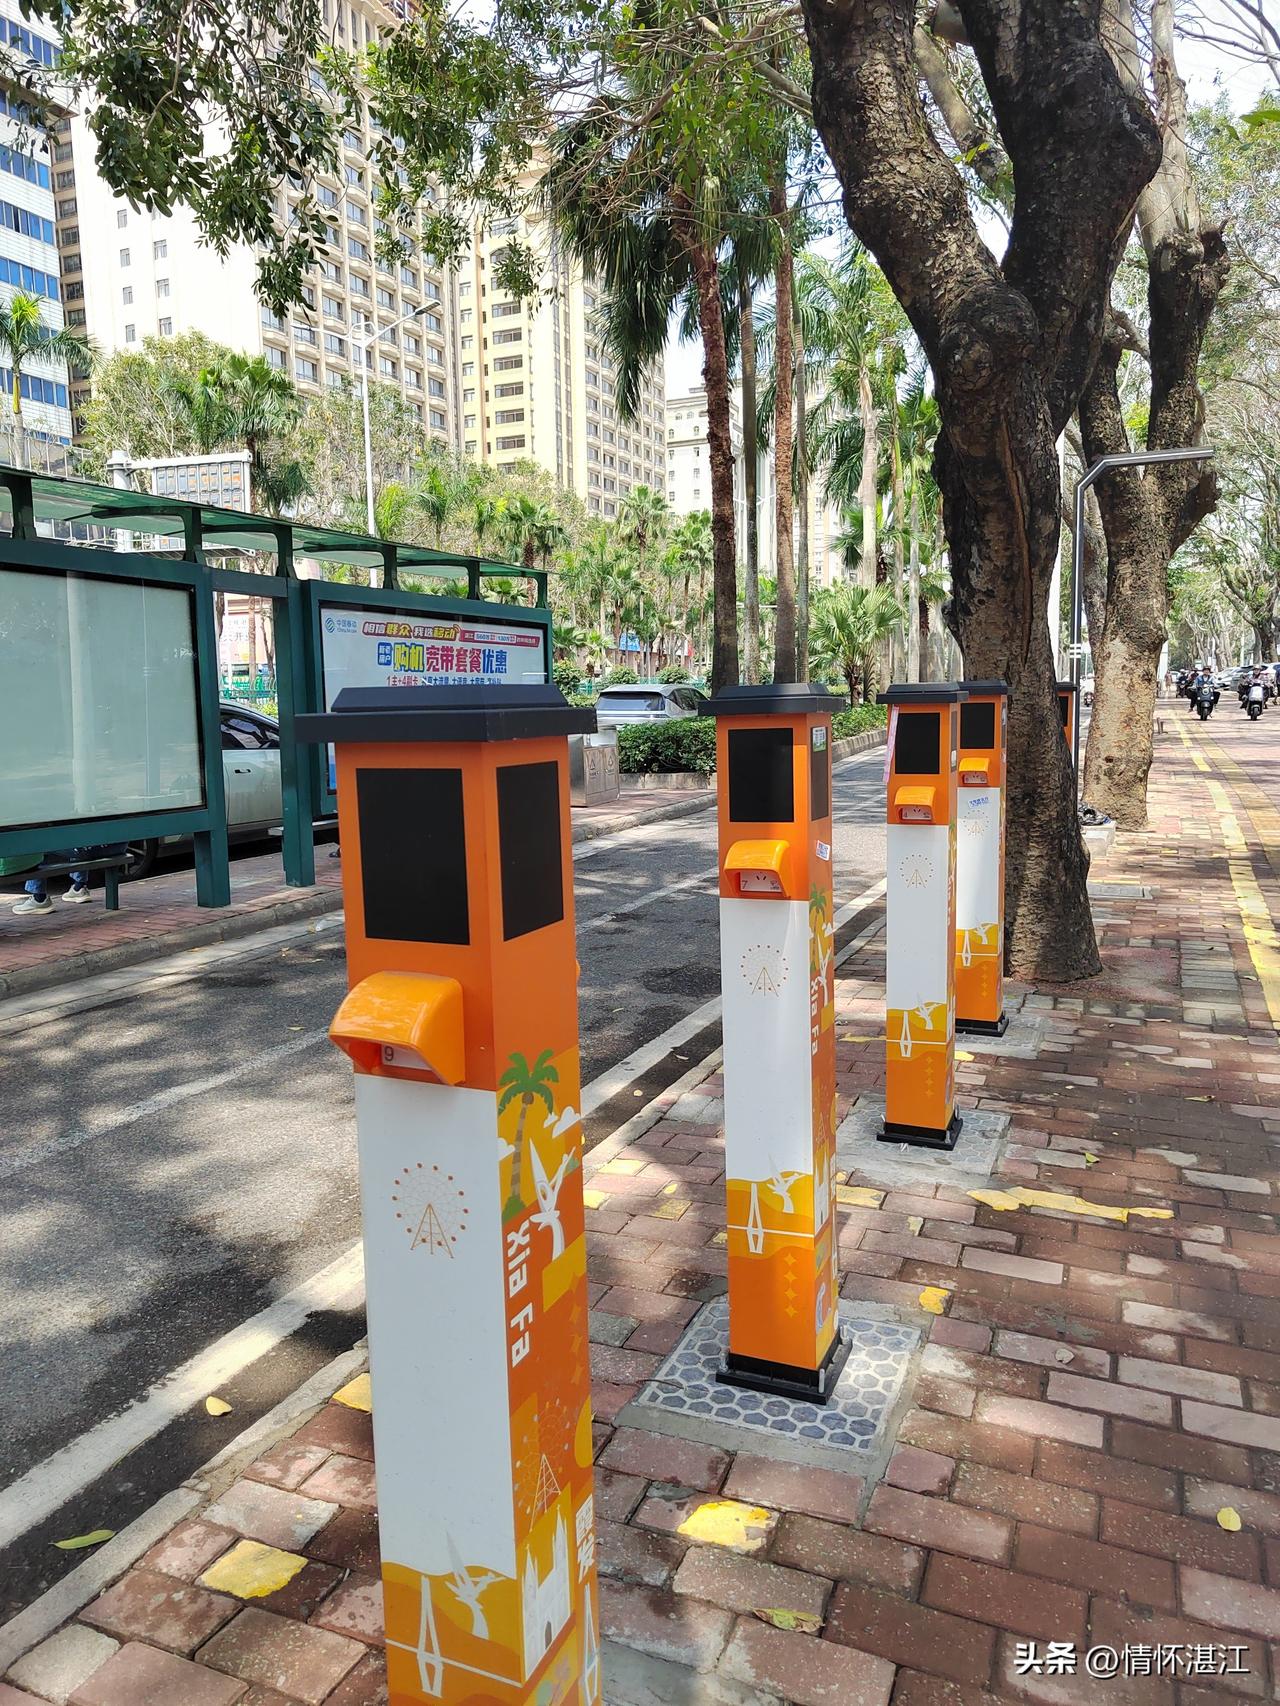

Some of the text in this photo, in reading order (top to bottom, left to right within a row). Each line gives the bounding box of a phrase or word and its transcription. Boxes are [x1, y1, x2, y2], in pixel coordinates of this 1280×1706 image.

[742, 880, 748, 889] 7
[384, 1046, 394, 1061] 9
[510, 1303, 534, 1368] Fa
